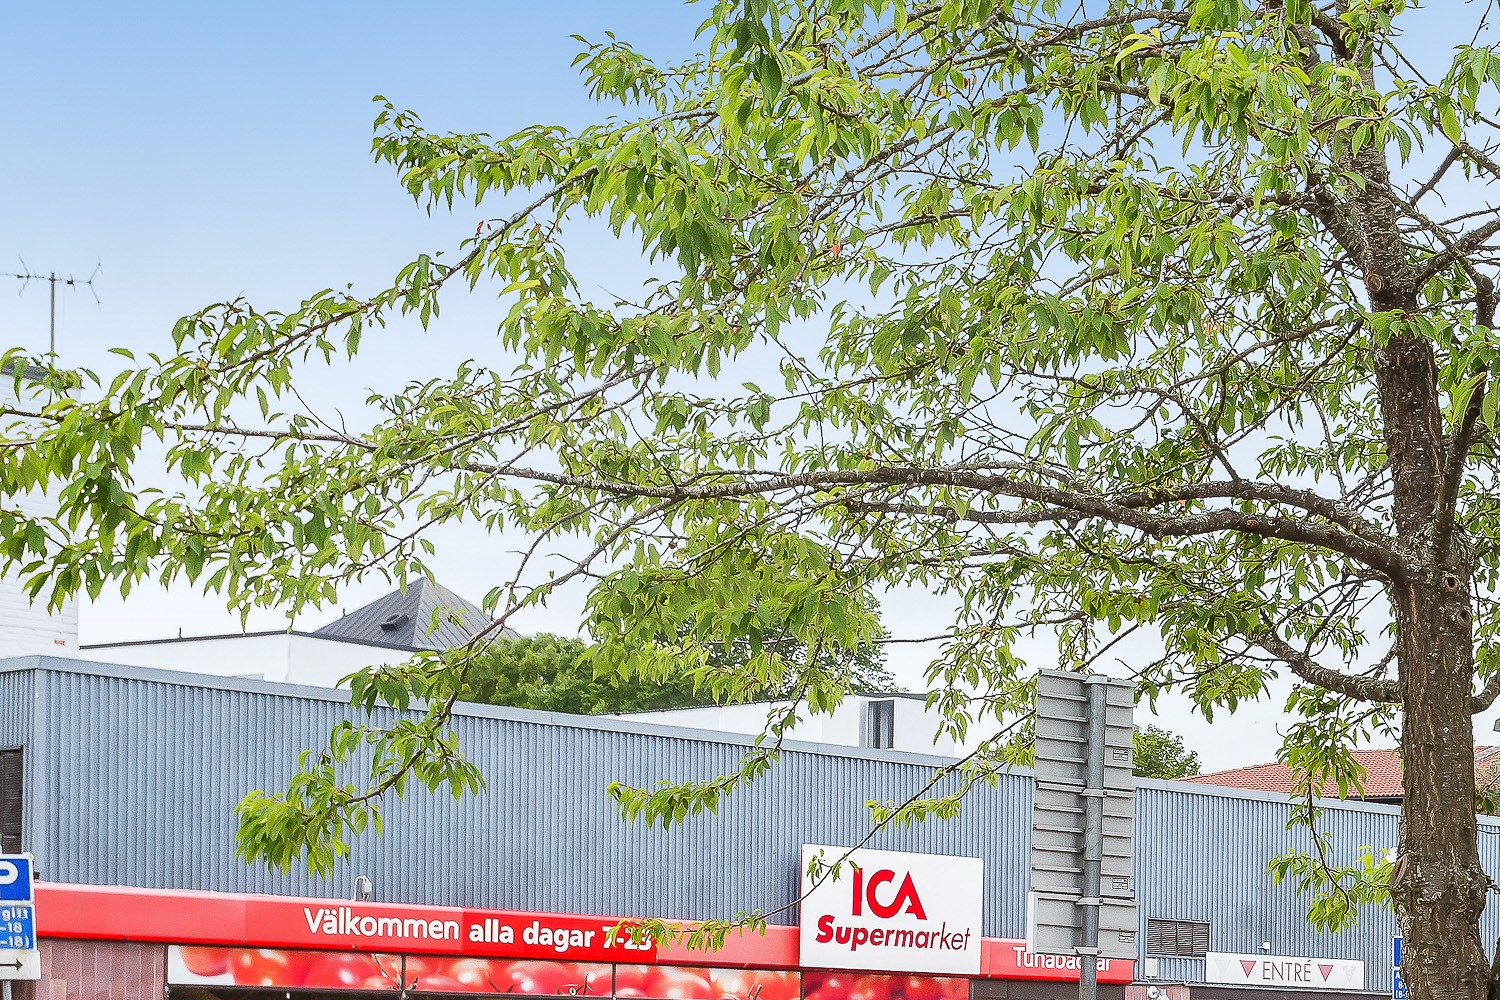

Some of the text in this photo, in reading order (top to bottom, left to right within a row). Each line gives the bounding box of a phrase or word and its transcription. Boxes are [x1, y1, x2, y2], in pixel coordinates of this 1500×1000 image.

[852, 868, 927, 920] ICA
[0, 921, 22, 933] -18
[304, 907, 459, 940] Välkommen
[469, 919, 514, 944] alla
[523, 921, 596, 952] dagar
[816, 914, 970, 951] Supermarket
[0, 935, 29, 948] -18)
[1013, 946, 1110, 971] Tunabaar
[1263, 960, 1311, 982] ENTRÉ
